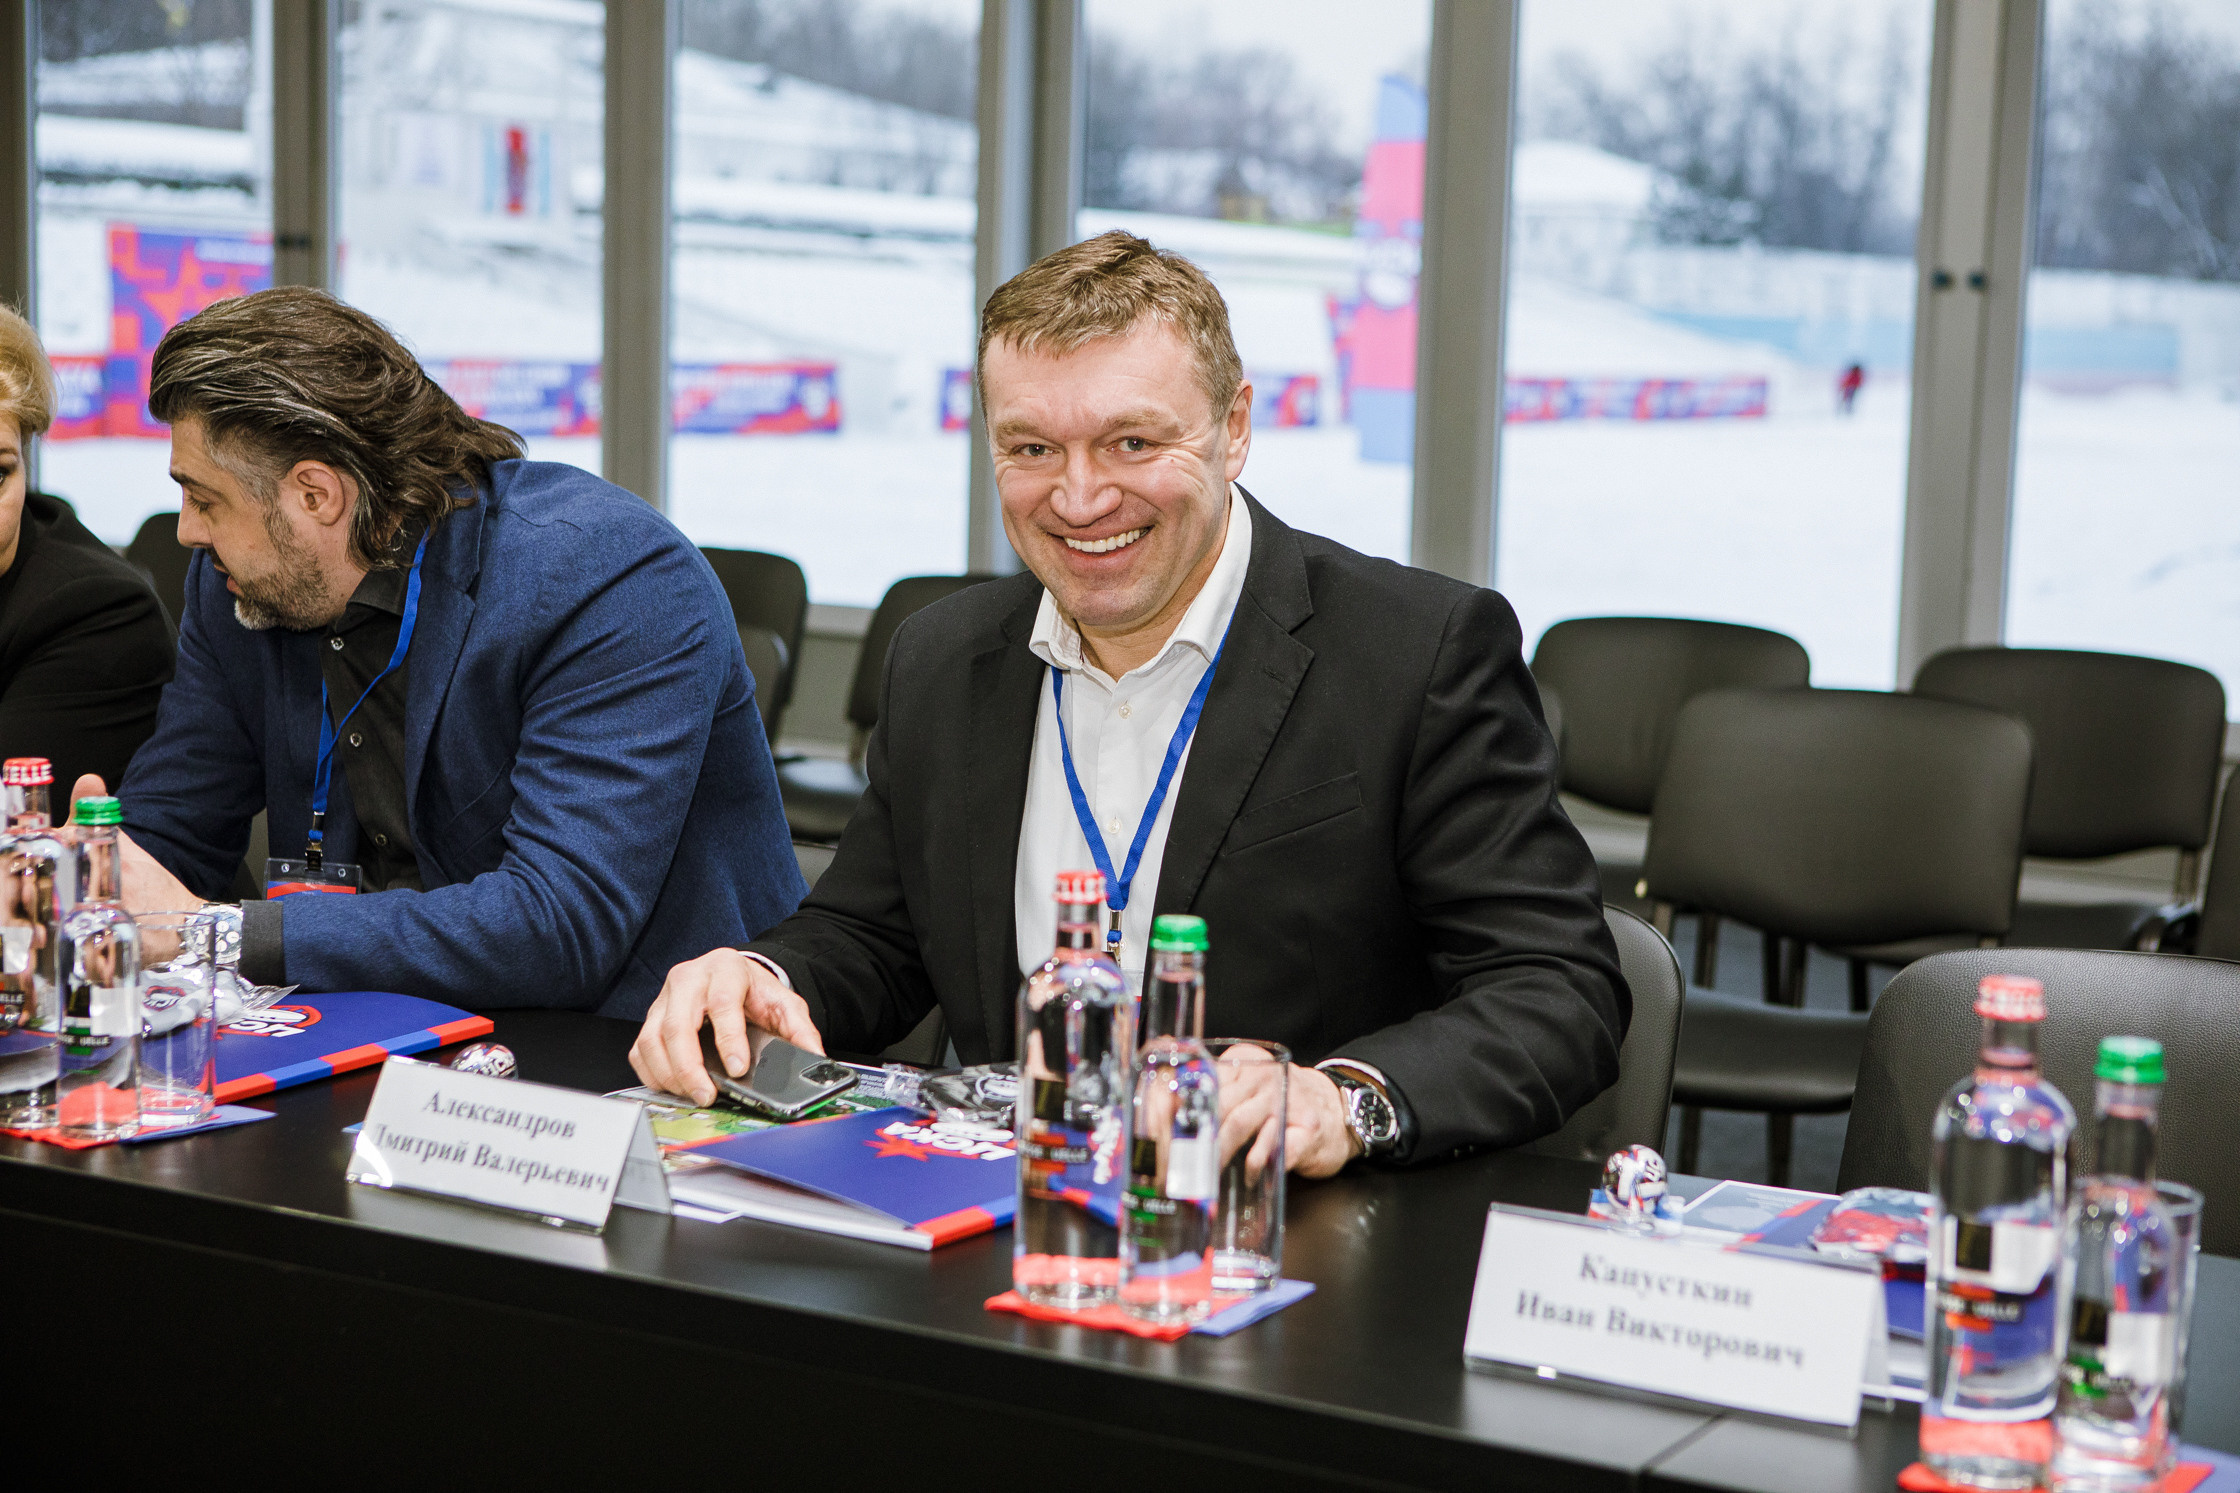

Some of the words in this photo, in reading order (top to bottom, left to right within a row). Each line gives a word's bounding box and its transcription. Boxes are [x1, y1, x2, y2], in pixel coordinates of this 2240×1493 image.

[3, 764, 52, 784] ELLE
[422, 1090, 577, 1139] Александров
[373, 1124, 468, 1163] Дмитрий
[472, 1142, 610, 1193] Валерьевич
[1579, 1253, 1753, 1308] Капусткин
[1515, 1290, 1594, 1331] Иван
[1606, 1307, 1805, 1368] Викторович
